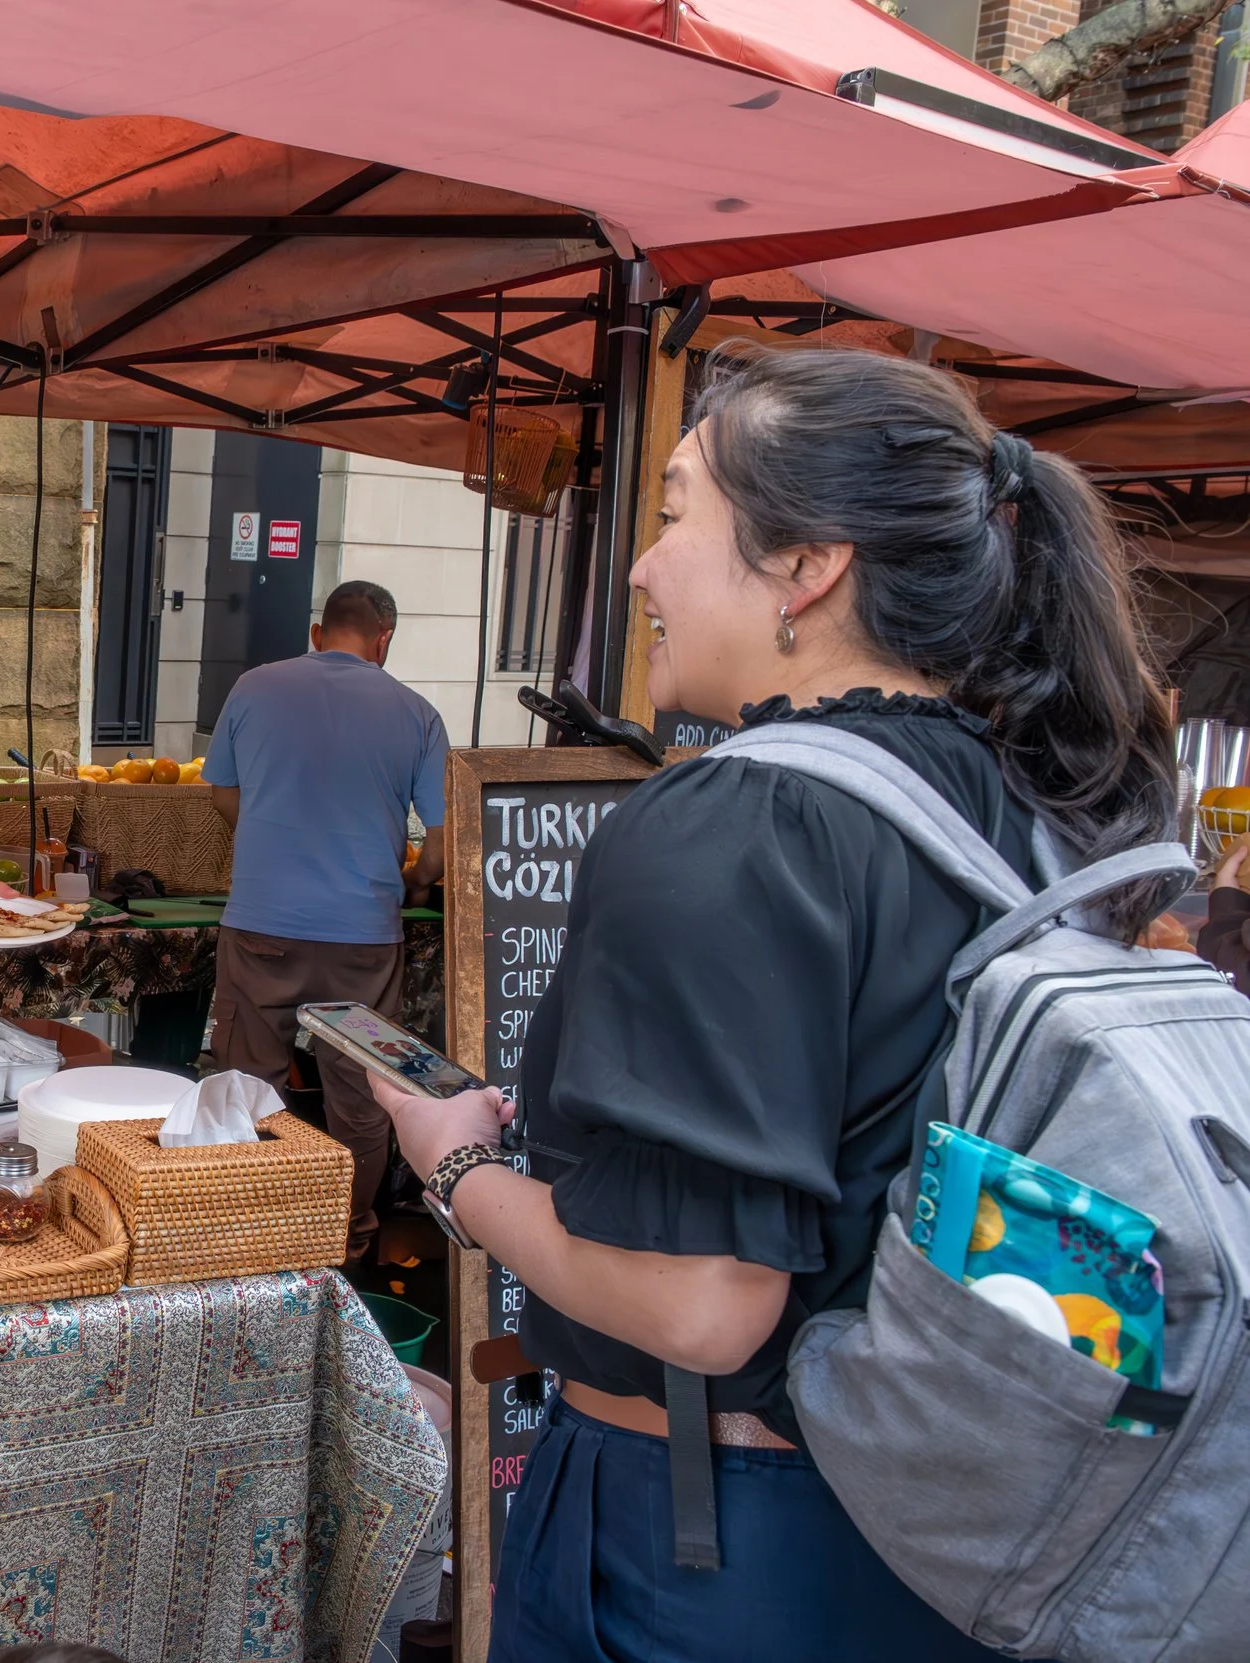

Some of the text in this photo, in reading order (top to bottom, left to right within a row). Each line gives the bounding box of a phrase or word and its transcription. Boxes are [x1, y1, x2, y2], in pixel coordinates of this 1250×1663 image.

[271, 541, 296, 552] BOOSTER
[675, 723, 704, 747] ADD
[498, 1010, 534, 1040] SPI
